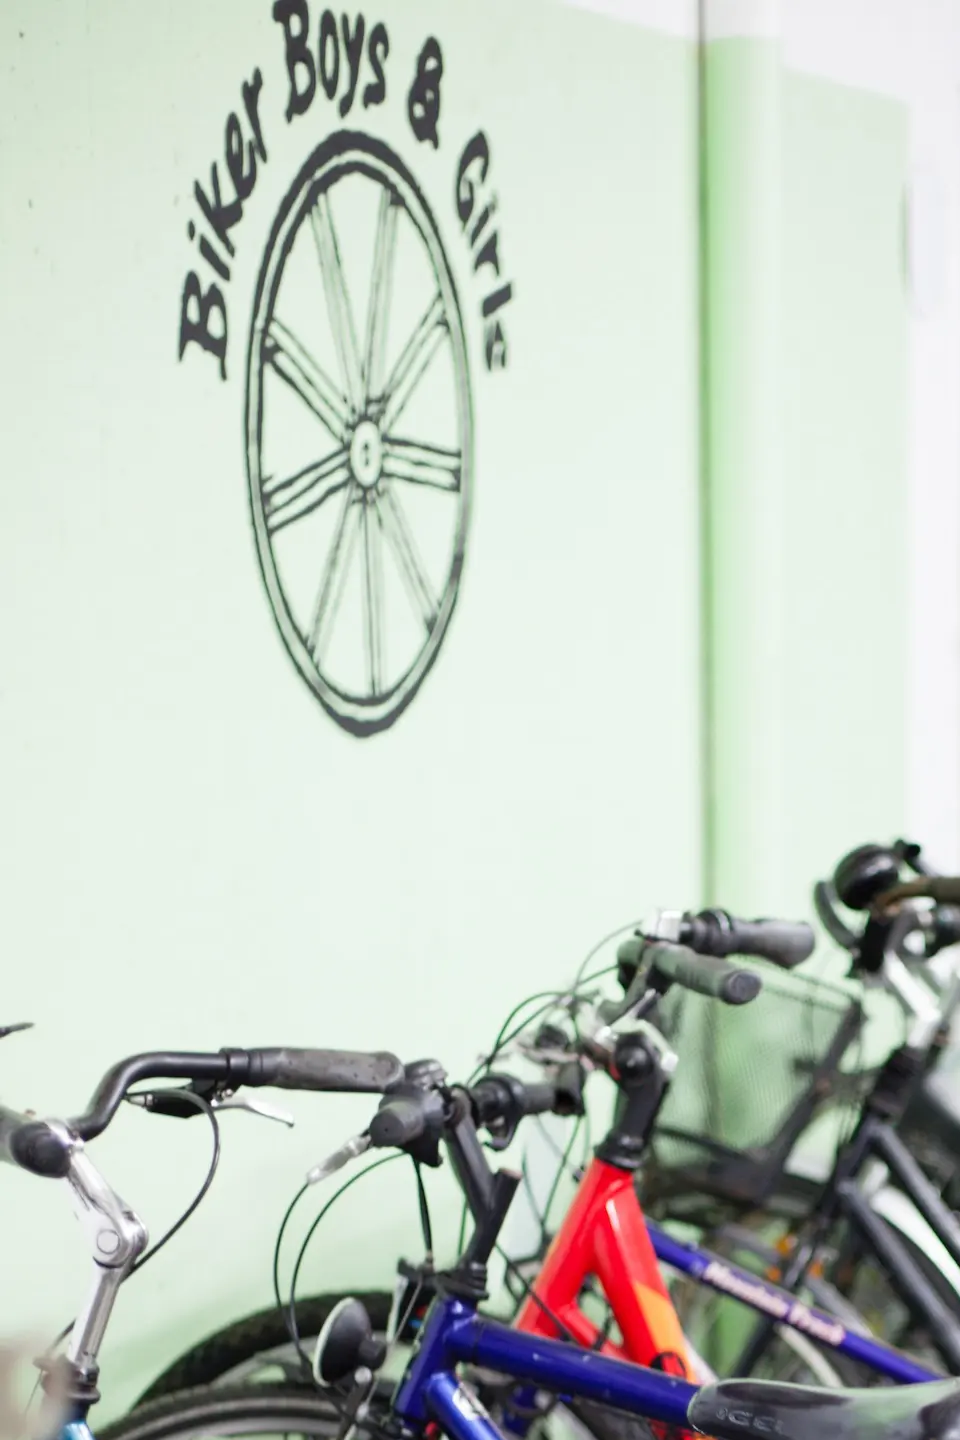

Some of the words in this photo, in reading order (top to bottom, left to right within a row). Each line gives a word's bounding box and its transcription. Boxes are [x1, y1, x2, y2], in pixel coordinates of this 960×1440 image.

[178, 67, 268, 380] Biker
[272, 0, 390, 124] Boys
[407, 36, 444, 149] &
